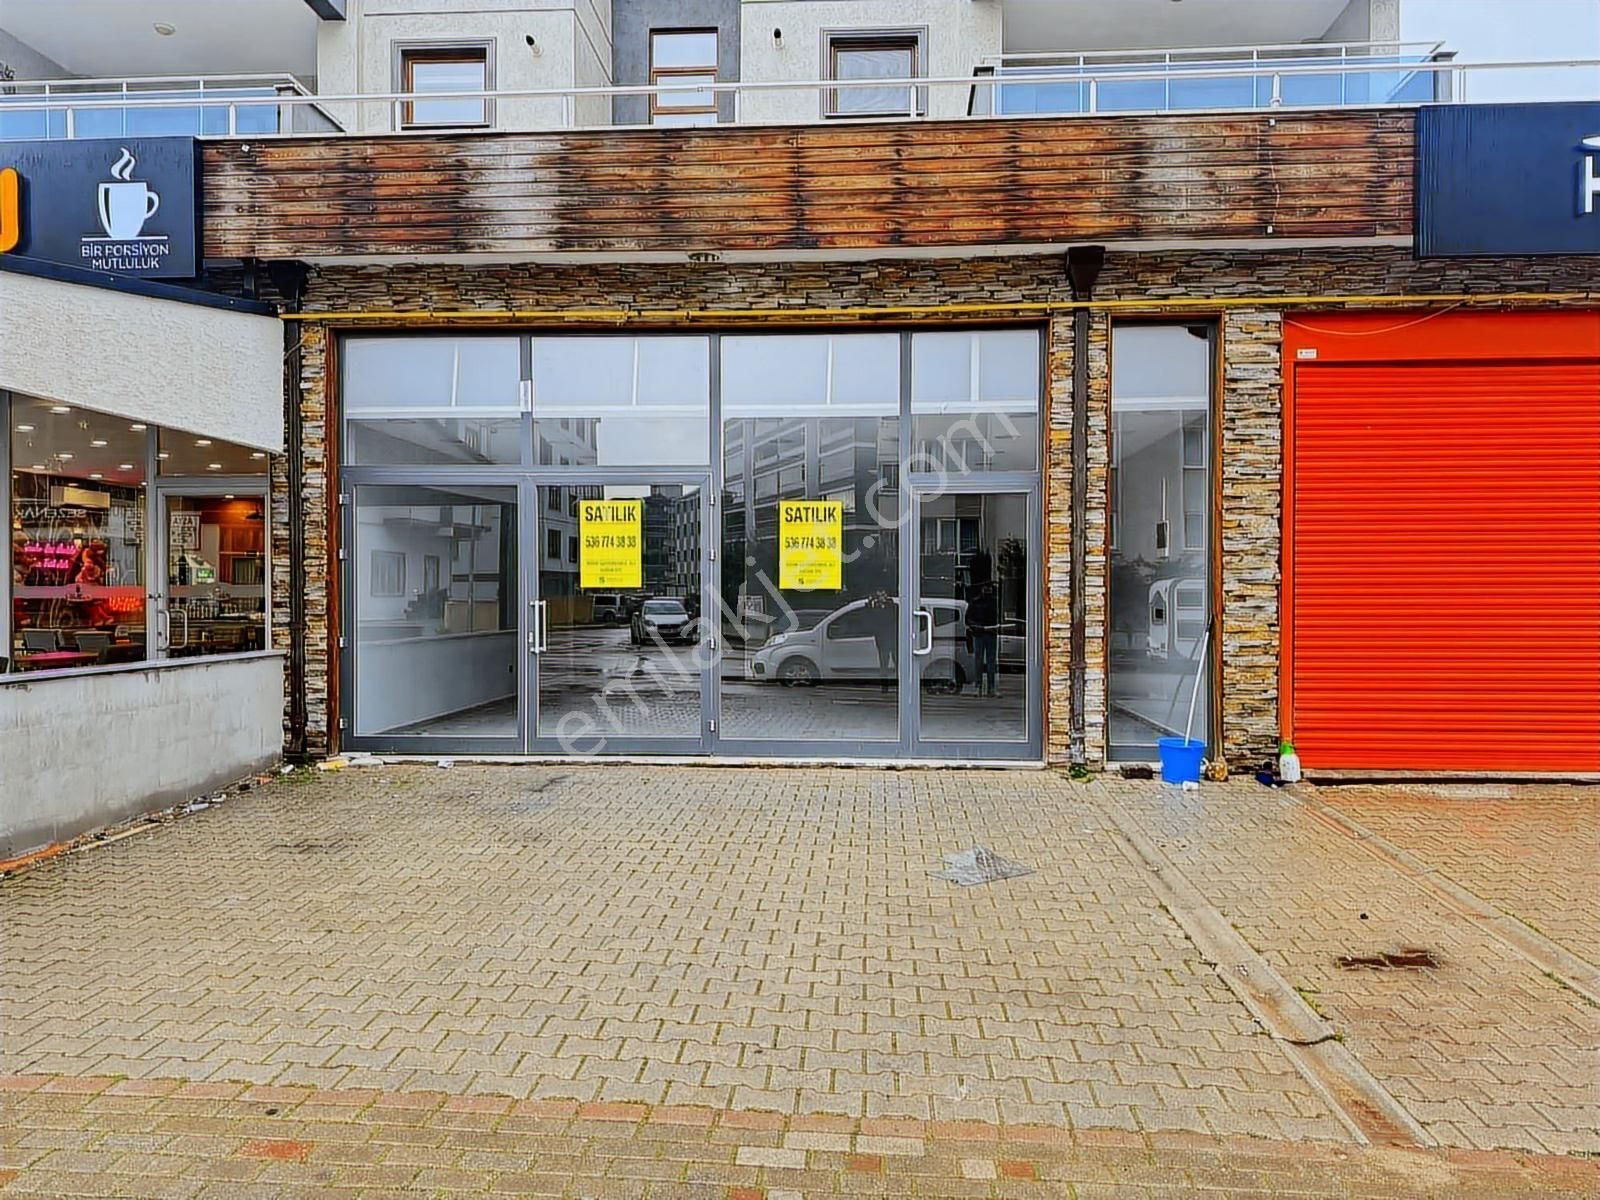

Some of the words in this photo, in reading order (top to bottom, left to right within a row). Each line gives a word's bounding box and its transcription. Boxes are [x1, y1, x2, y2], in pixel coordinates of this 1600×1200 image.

[92, 258, 159, 269] MUTLULUK
[585, 505, 636, 522] SATILIK
[785, 507, 836, 523] SATILIK
[601, 535, 614, 548] 774
[801, 536, 814, 549] 774
